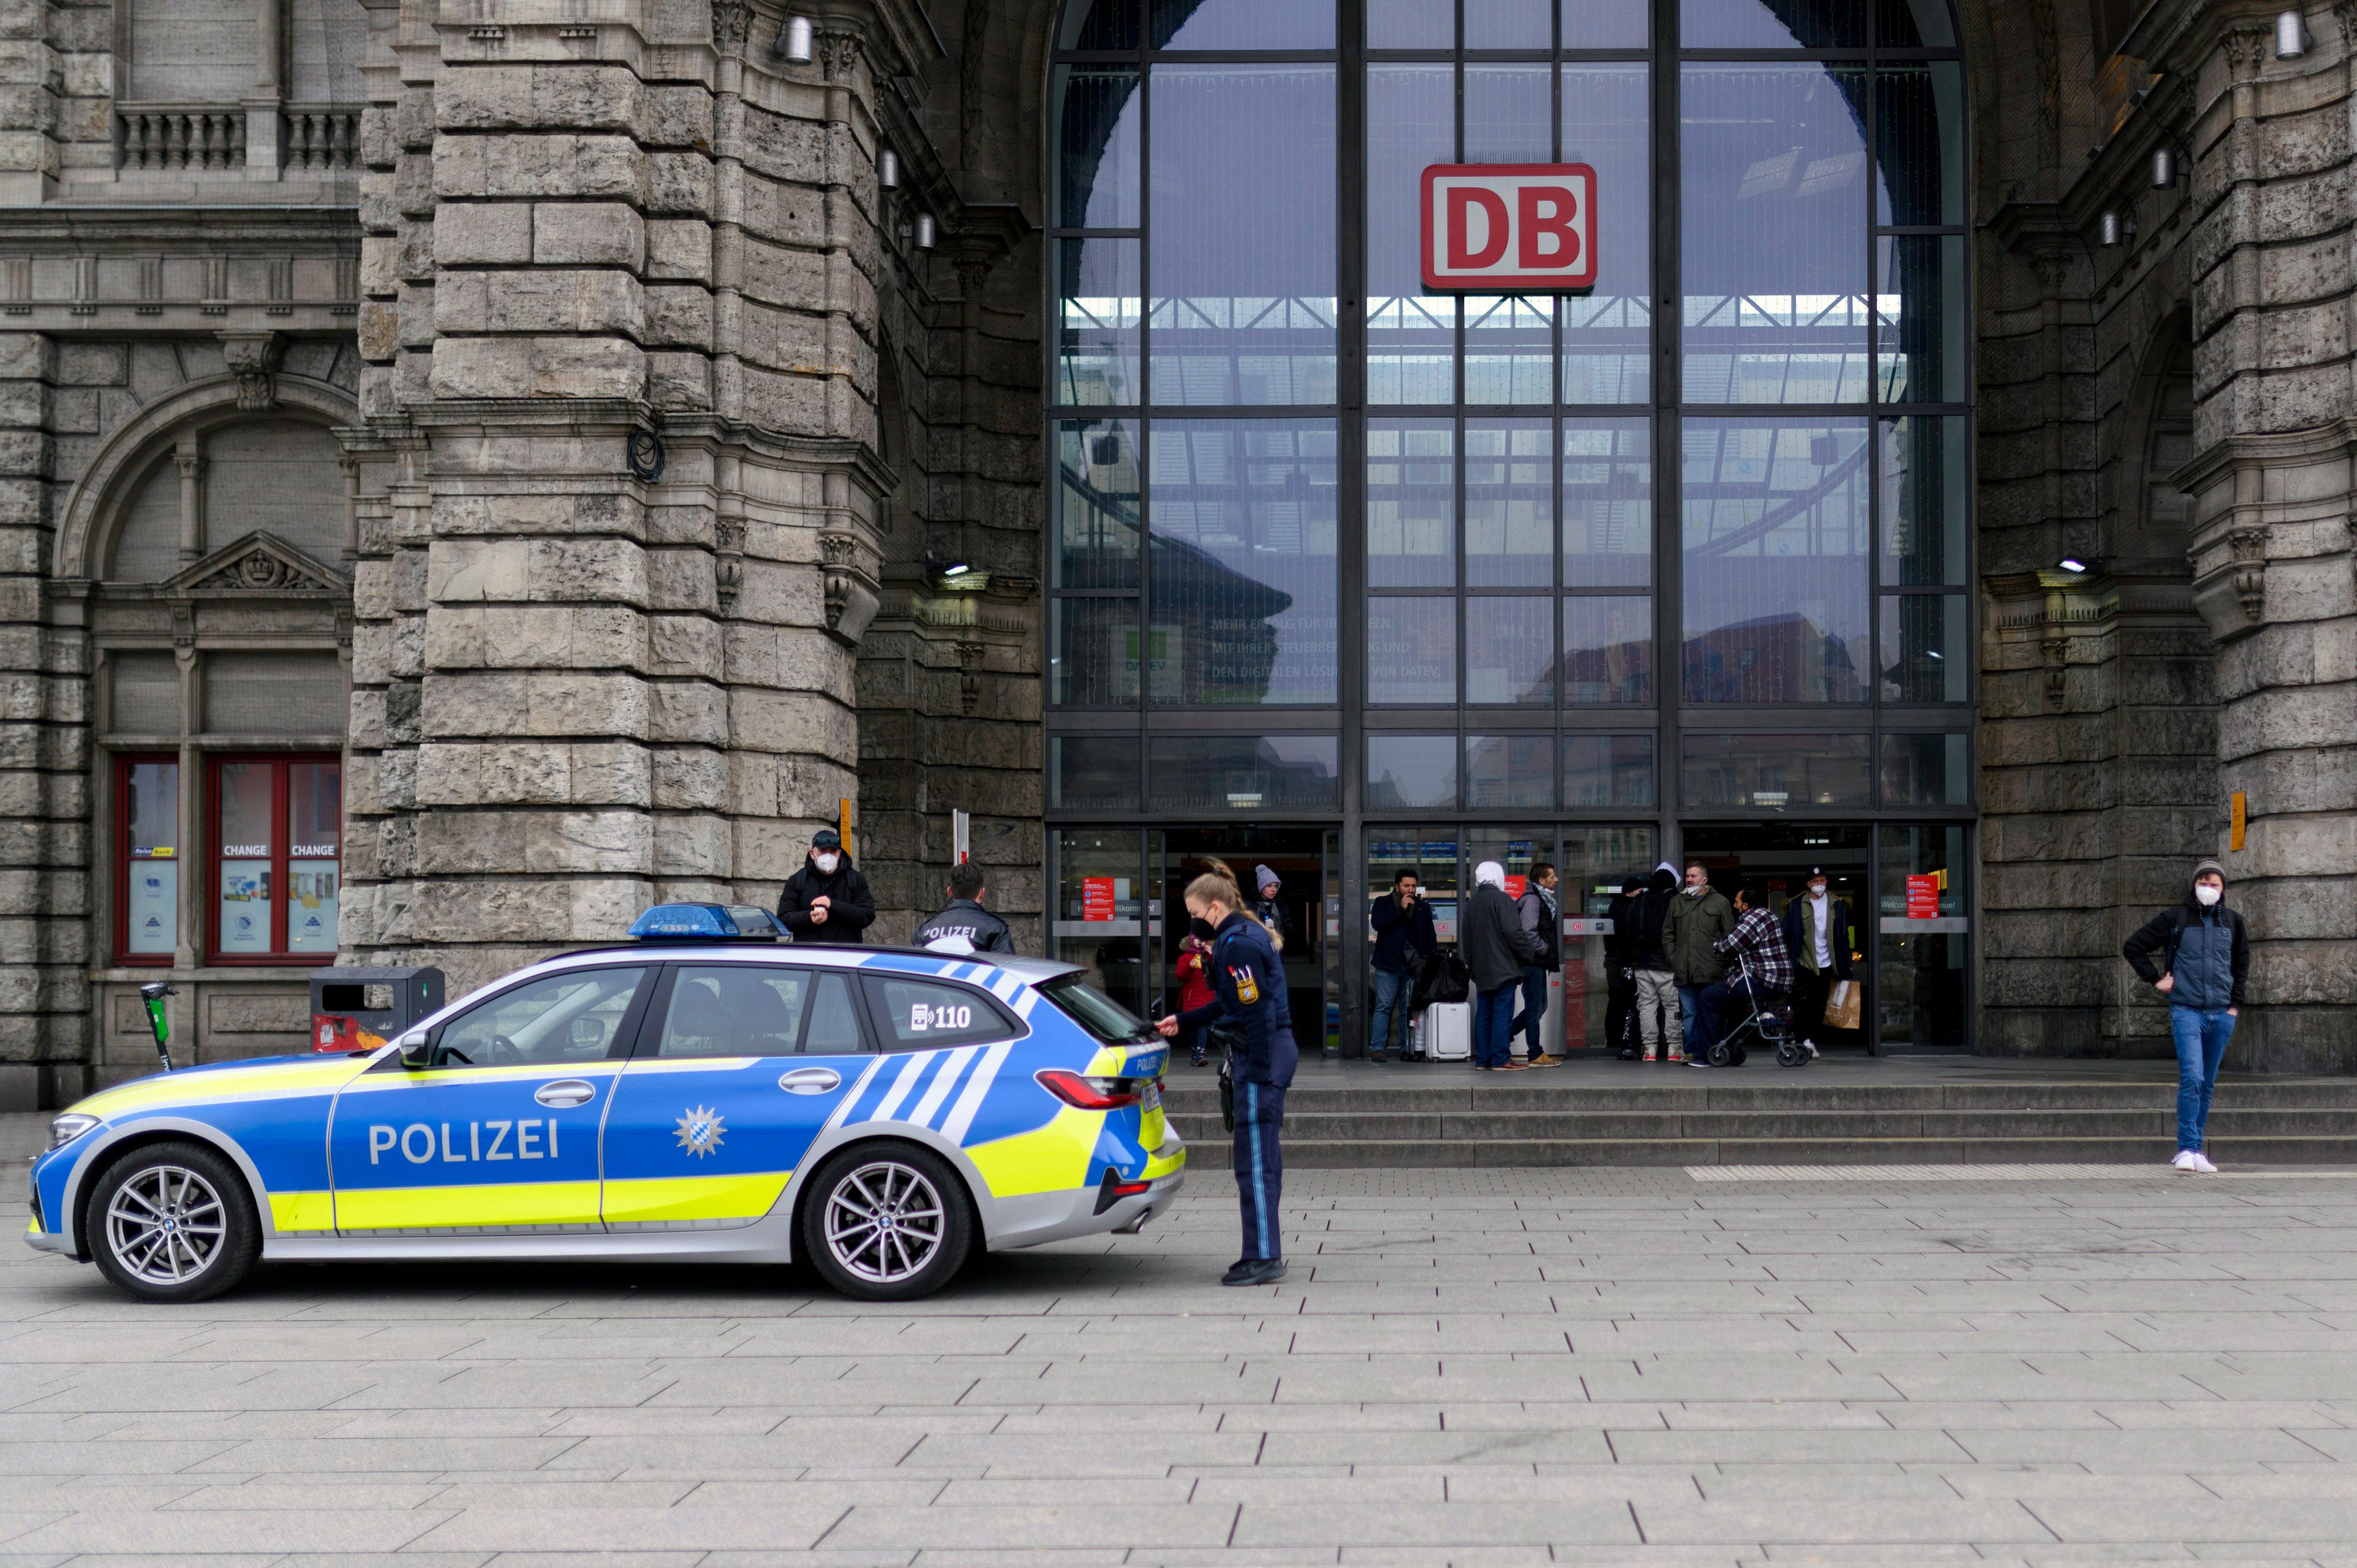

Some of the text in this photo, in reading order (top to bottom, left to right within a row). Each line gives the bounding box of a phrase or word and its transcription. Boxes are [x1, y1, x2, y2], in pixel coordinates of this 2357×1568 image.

[1446, 186, 1581, 269] DB
[1213, 619, 1245, 630] MEHR
[1251, 619, 1294, 630] ERFOLG
[1298, 616, 1320, 630] FÜR
[1213, 642, 1233, 654] MIT
[1237, 642, 1271, 654] IHRER
[1384, 642, 1410, 653] UND
[1212, 666, 1236, 678] DEN
[1240, 666, 1300, 678] DIGITALEN
[1371, 666, 1397, 678] VON
[224, 845, 267, 856] CHANGE
[291, 845, 335, 856] CHANGE
[923, 926, 977, 939] POLIZEI
[935, 1005, 971, 1028] 110
[1137, 1055, 1157, 1072] POLIZEI
[369, 1119, 558, 1164] POLIZEI
